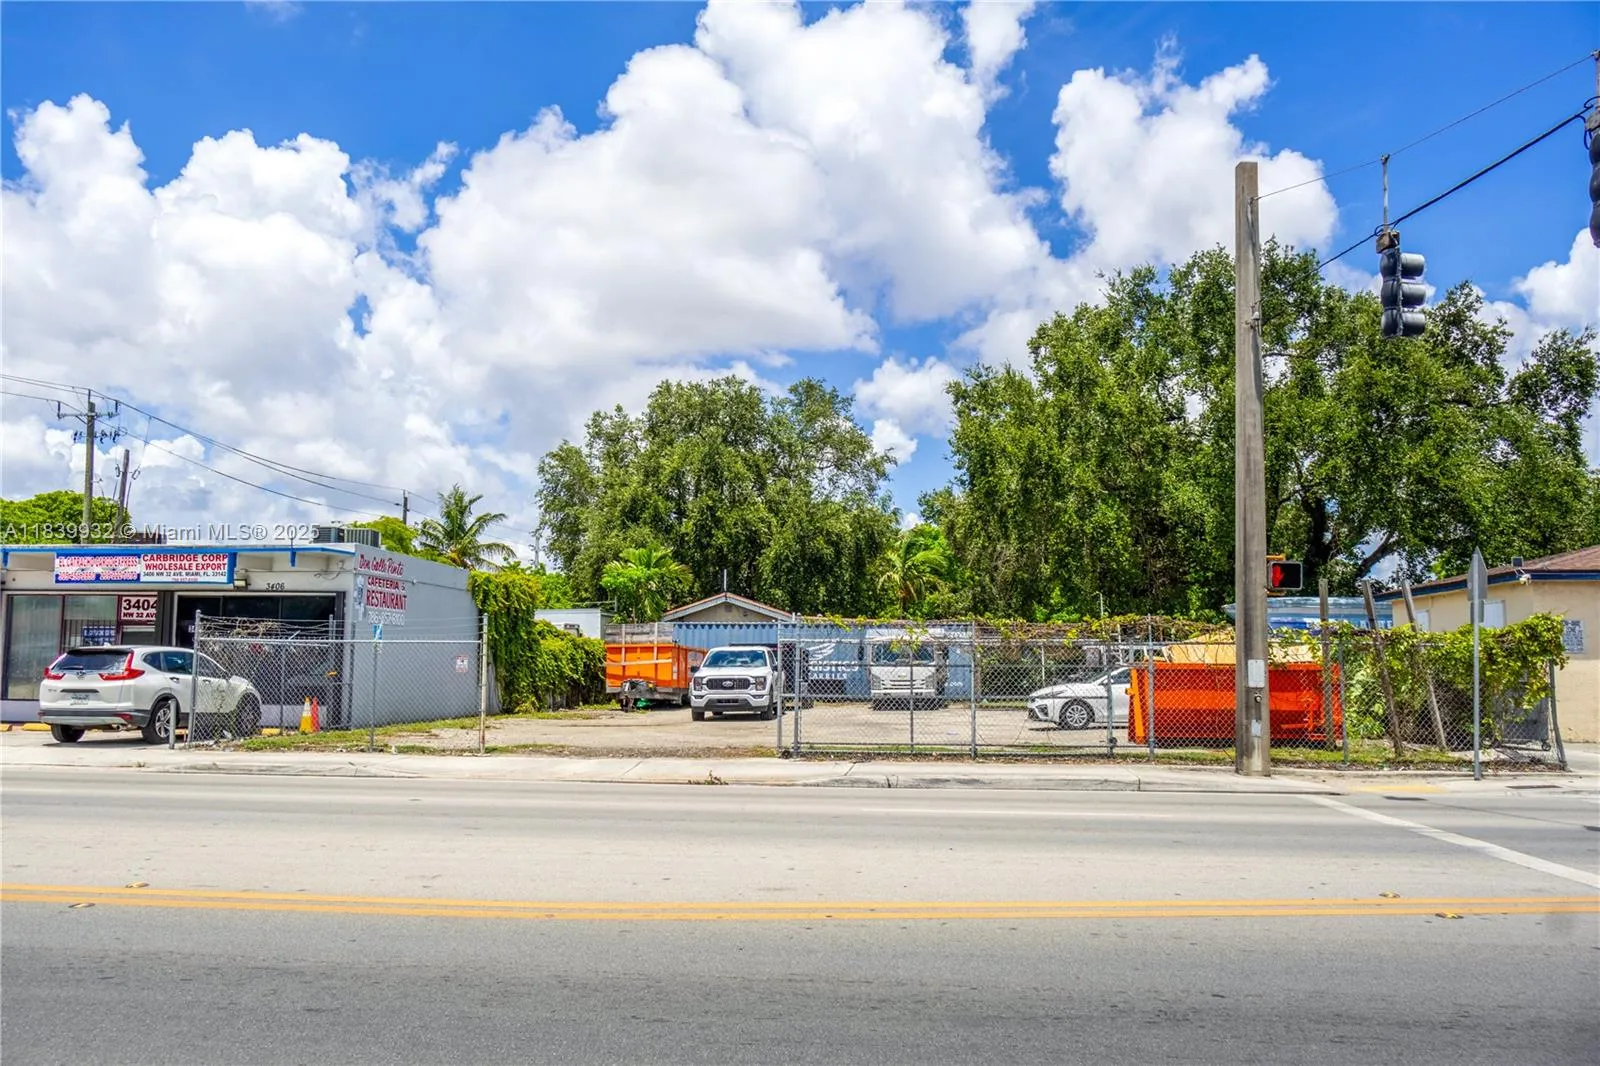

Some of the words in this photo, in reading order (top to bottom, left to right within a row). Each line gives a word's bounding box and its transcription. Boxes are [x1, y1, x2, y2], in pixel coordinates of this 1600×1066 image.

[142, 554, 198, 562] CARBRIDGE
[201, 554, 228, 562] CORP
[144, 562, 193, 571] WHOLESALE
[195, 562, 227, 571] EXPORT
[367, 576, 400, 591] CAFETERIA
[123, 599, 157, 611] 3404
[366, 589, 408, 611] RESTAURANT
